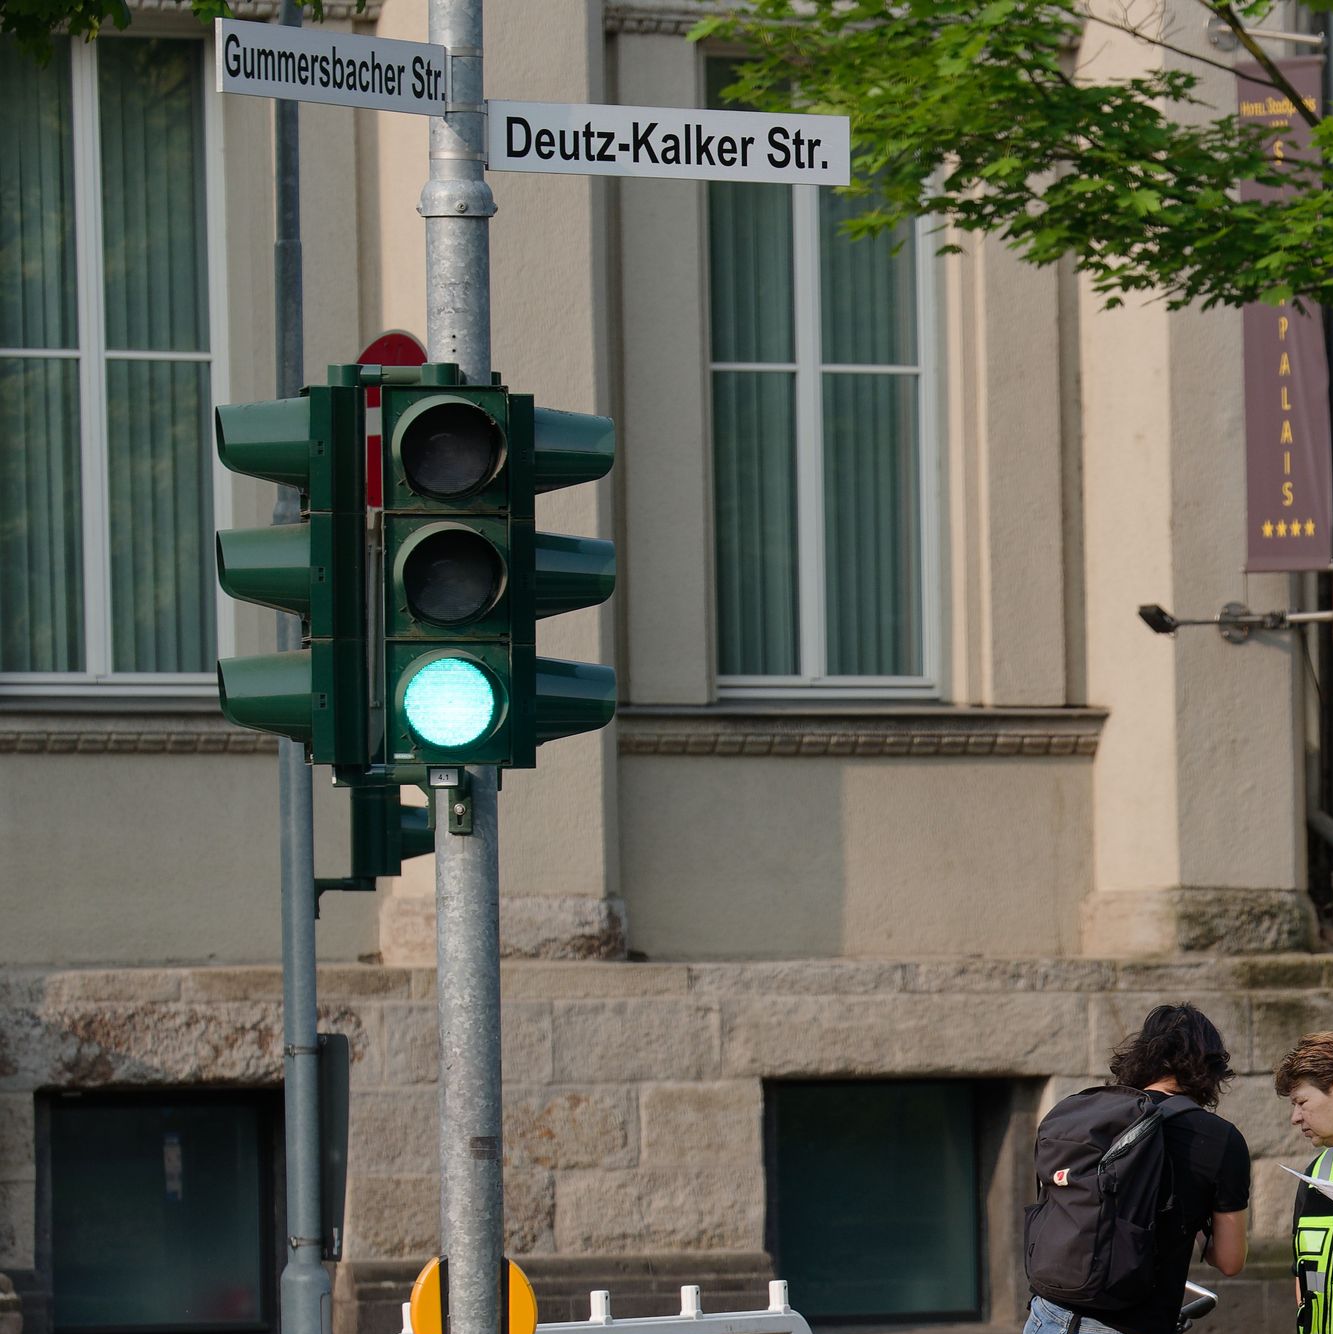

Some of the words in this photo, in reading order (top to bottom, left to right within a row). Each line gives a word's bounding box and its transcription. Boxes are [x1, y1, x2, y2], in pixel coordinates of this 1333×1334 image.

[224, 33, 405, 96] Gummersbacher
[411, 55, 446, 101] Str.
[505, 115, 755, 167] Deutz-Kalker
[767, 126, 828, 169] Str.
